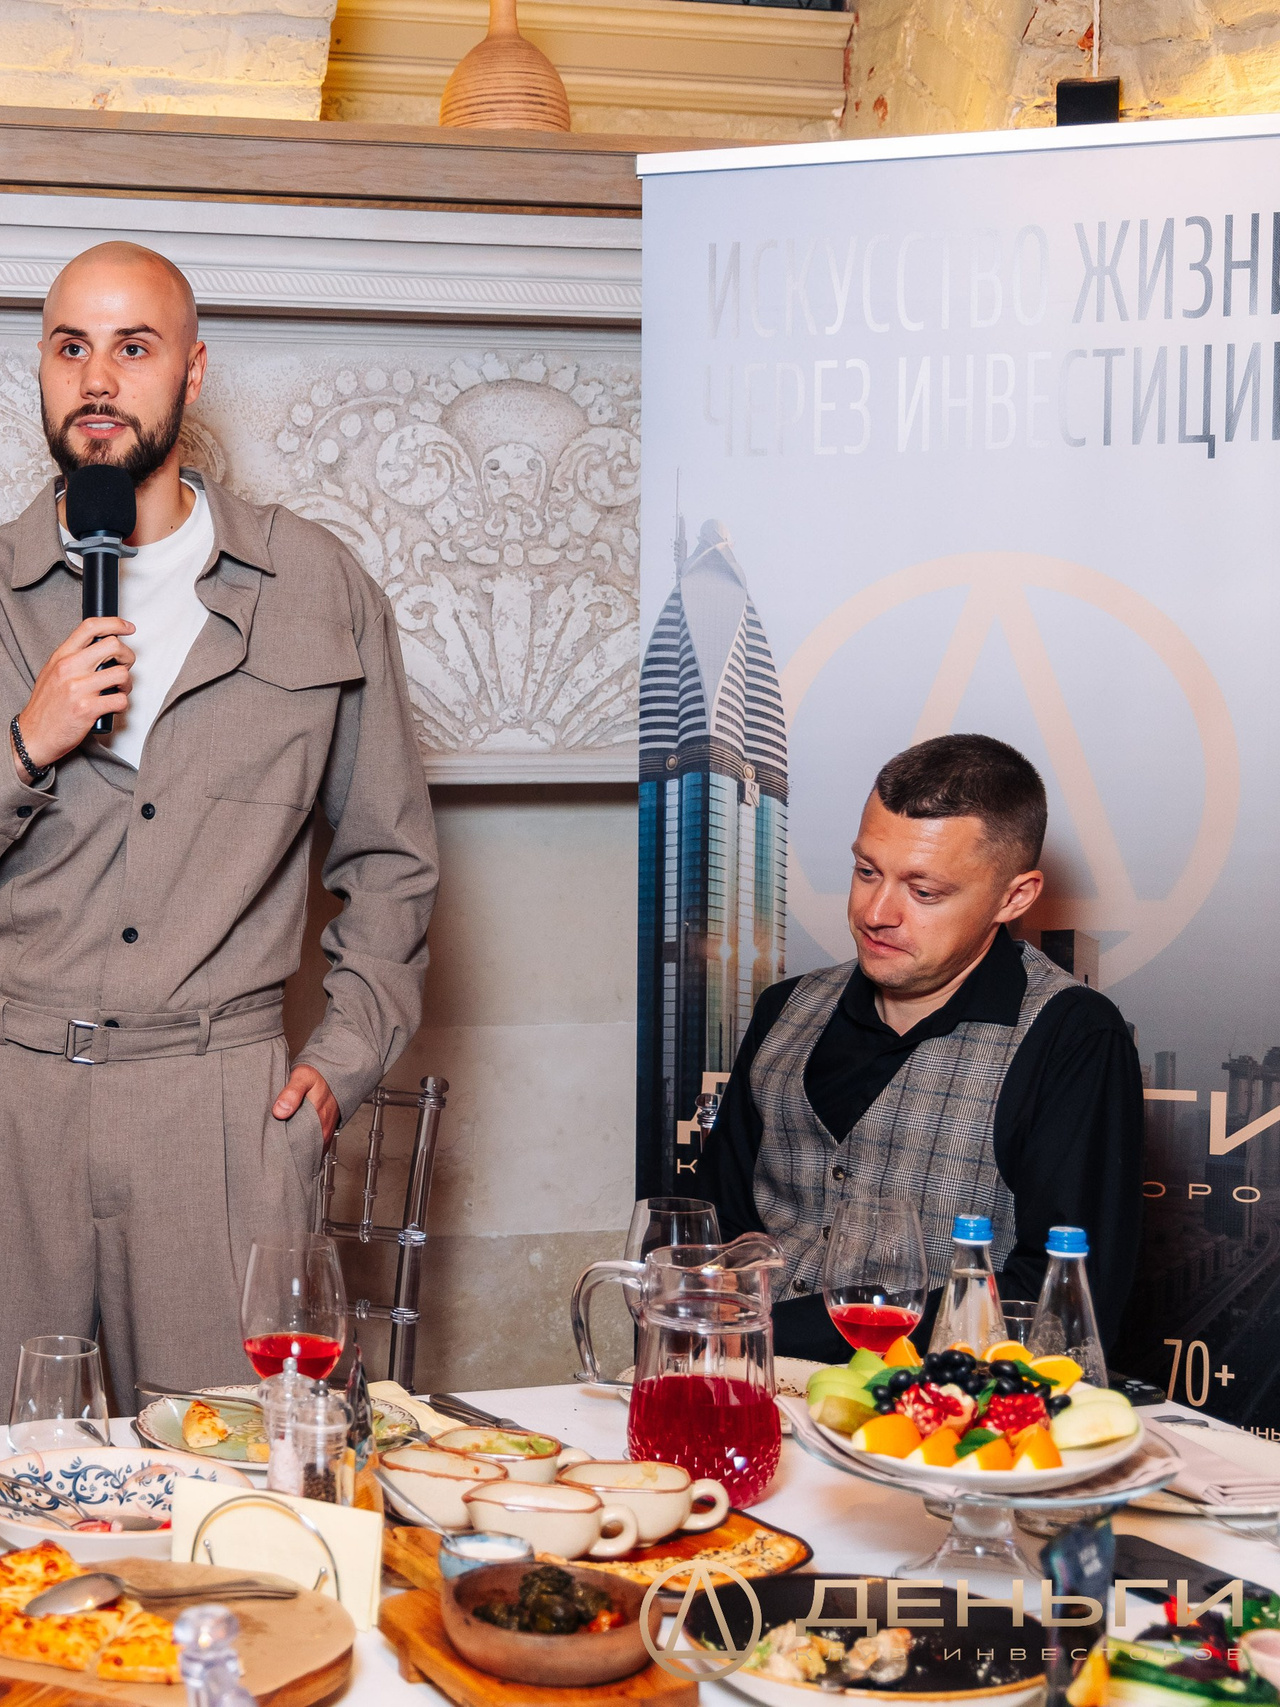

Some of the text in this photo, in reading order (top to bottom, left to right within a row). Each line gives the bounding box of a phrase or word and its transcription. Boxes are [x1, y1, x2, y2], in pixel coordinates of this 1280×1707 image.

[708, 212, 1280, 338] ИСКУССТВО ЖИЗН
[703, 341, 1280, 459] ЧЕРЕЗ ИНВЕСТИЦИ
[1164, 1339, 1235, 1407] 70+
